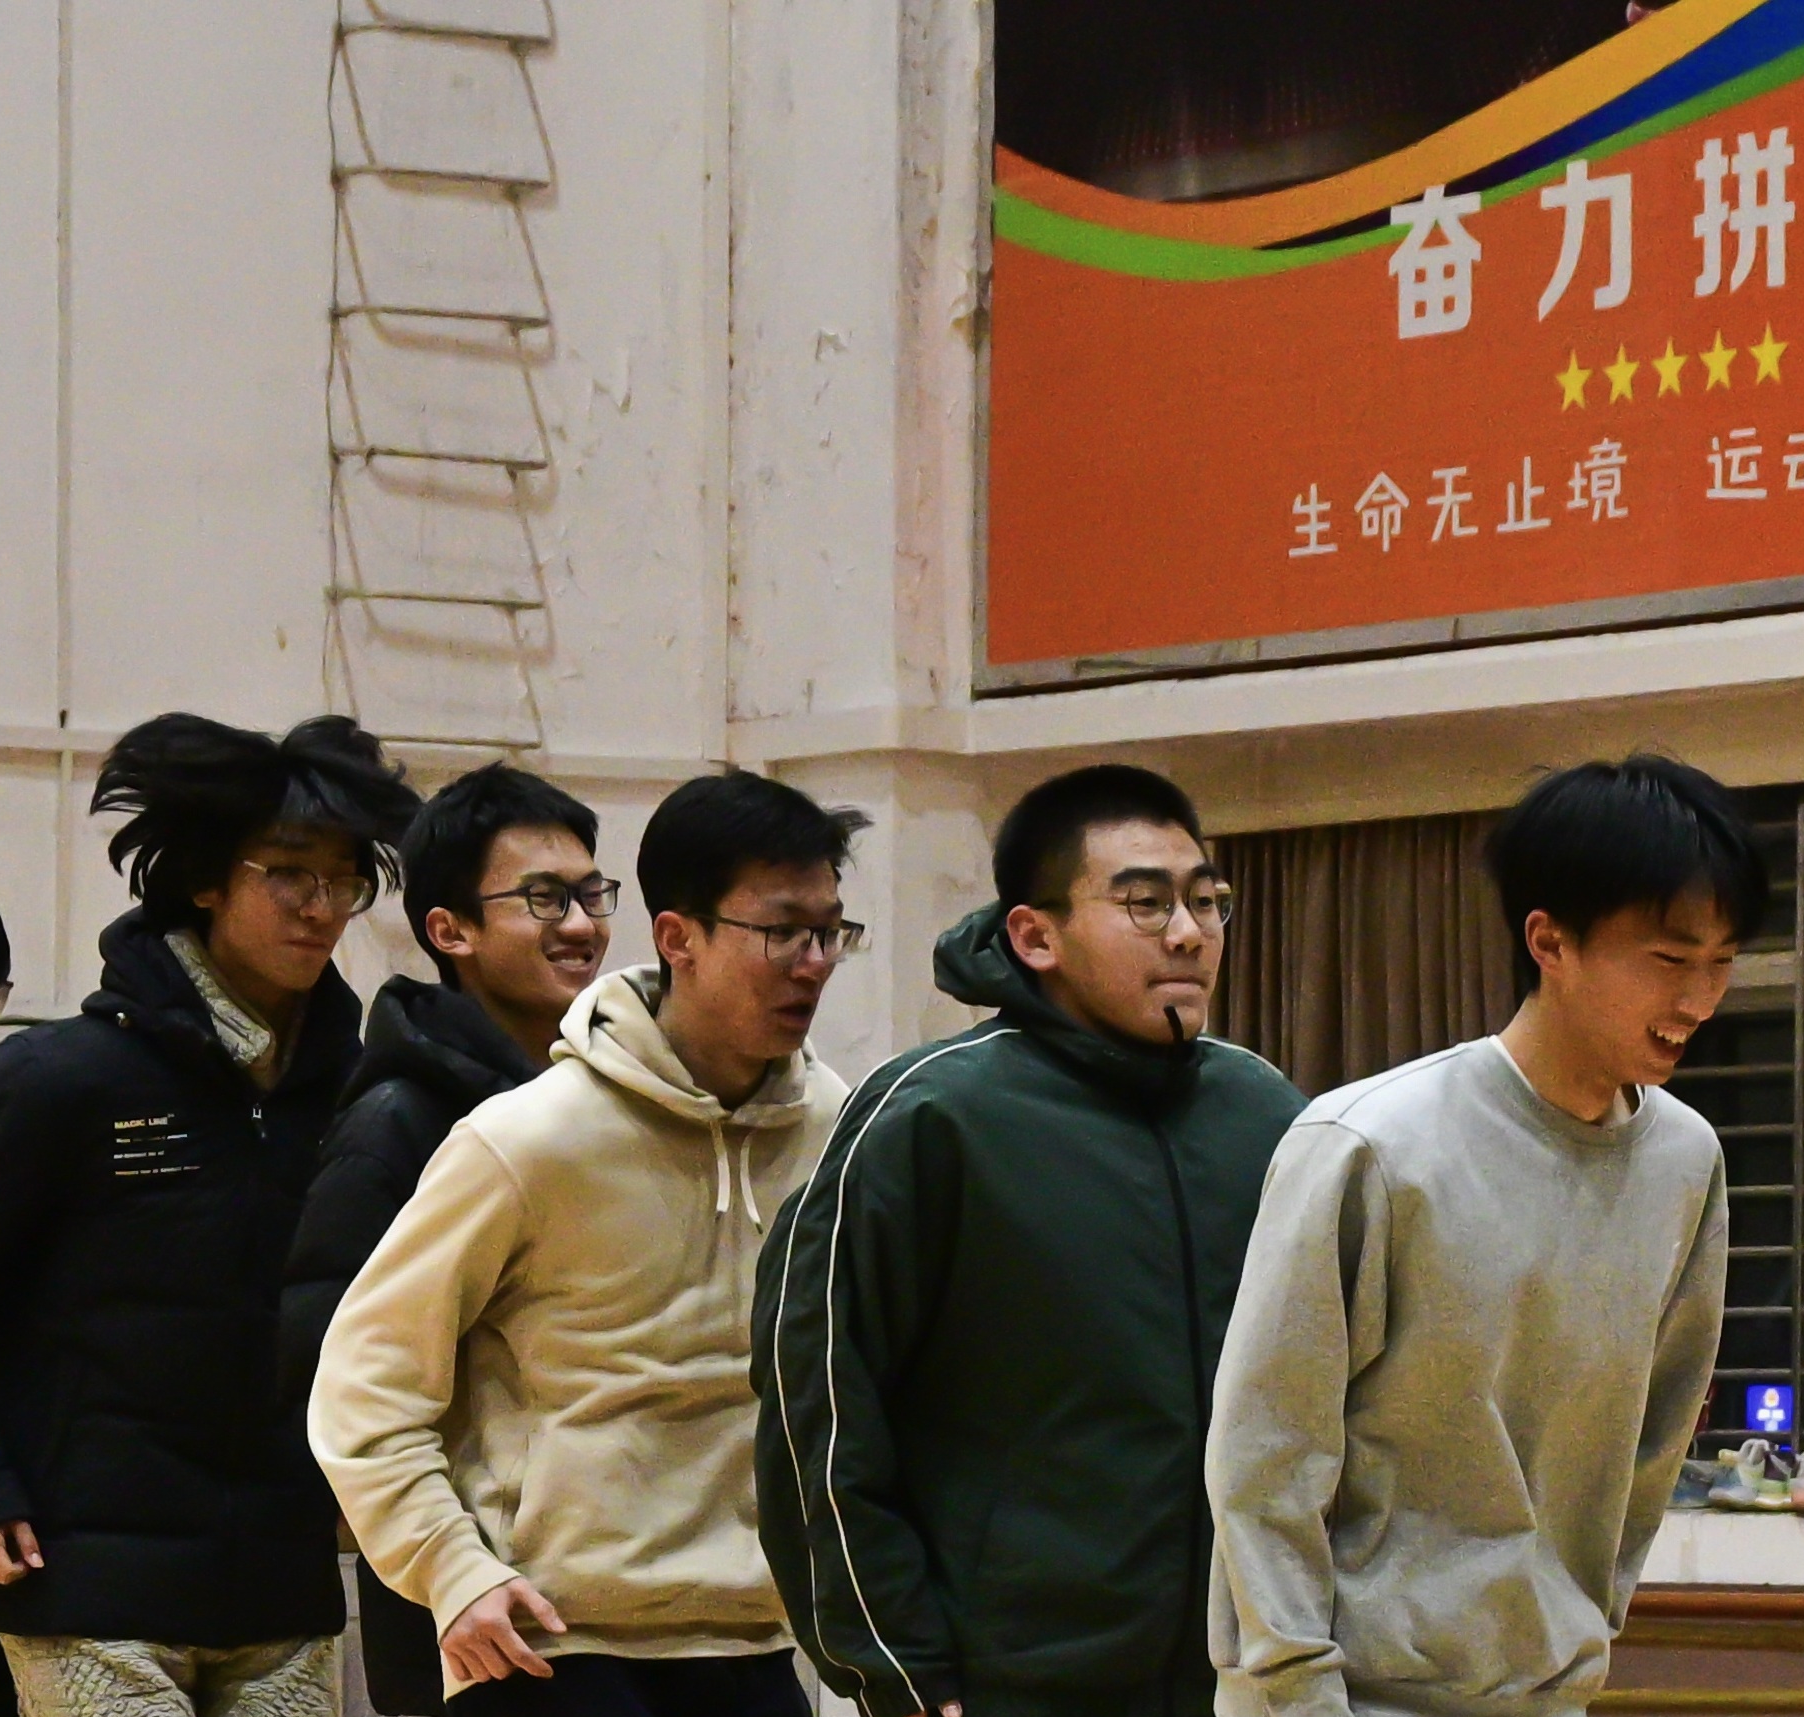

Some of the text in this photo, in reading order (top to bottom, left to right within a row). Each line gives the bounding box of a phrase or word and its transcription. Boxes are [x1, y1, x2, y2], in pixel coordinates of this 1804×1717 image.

[1288, 437, 1628, 557] 生命无止境
